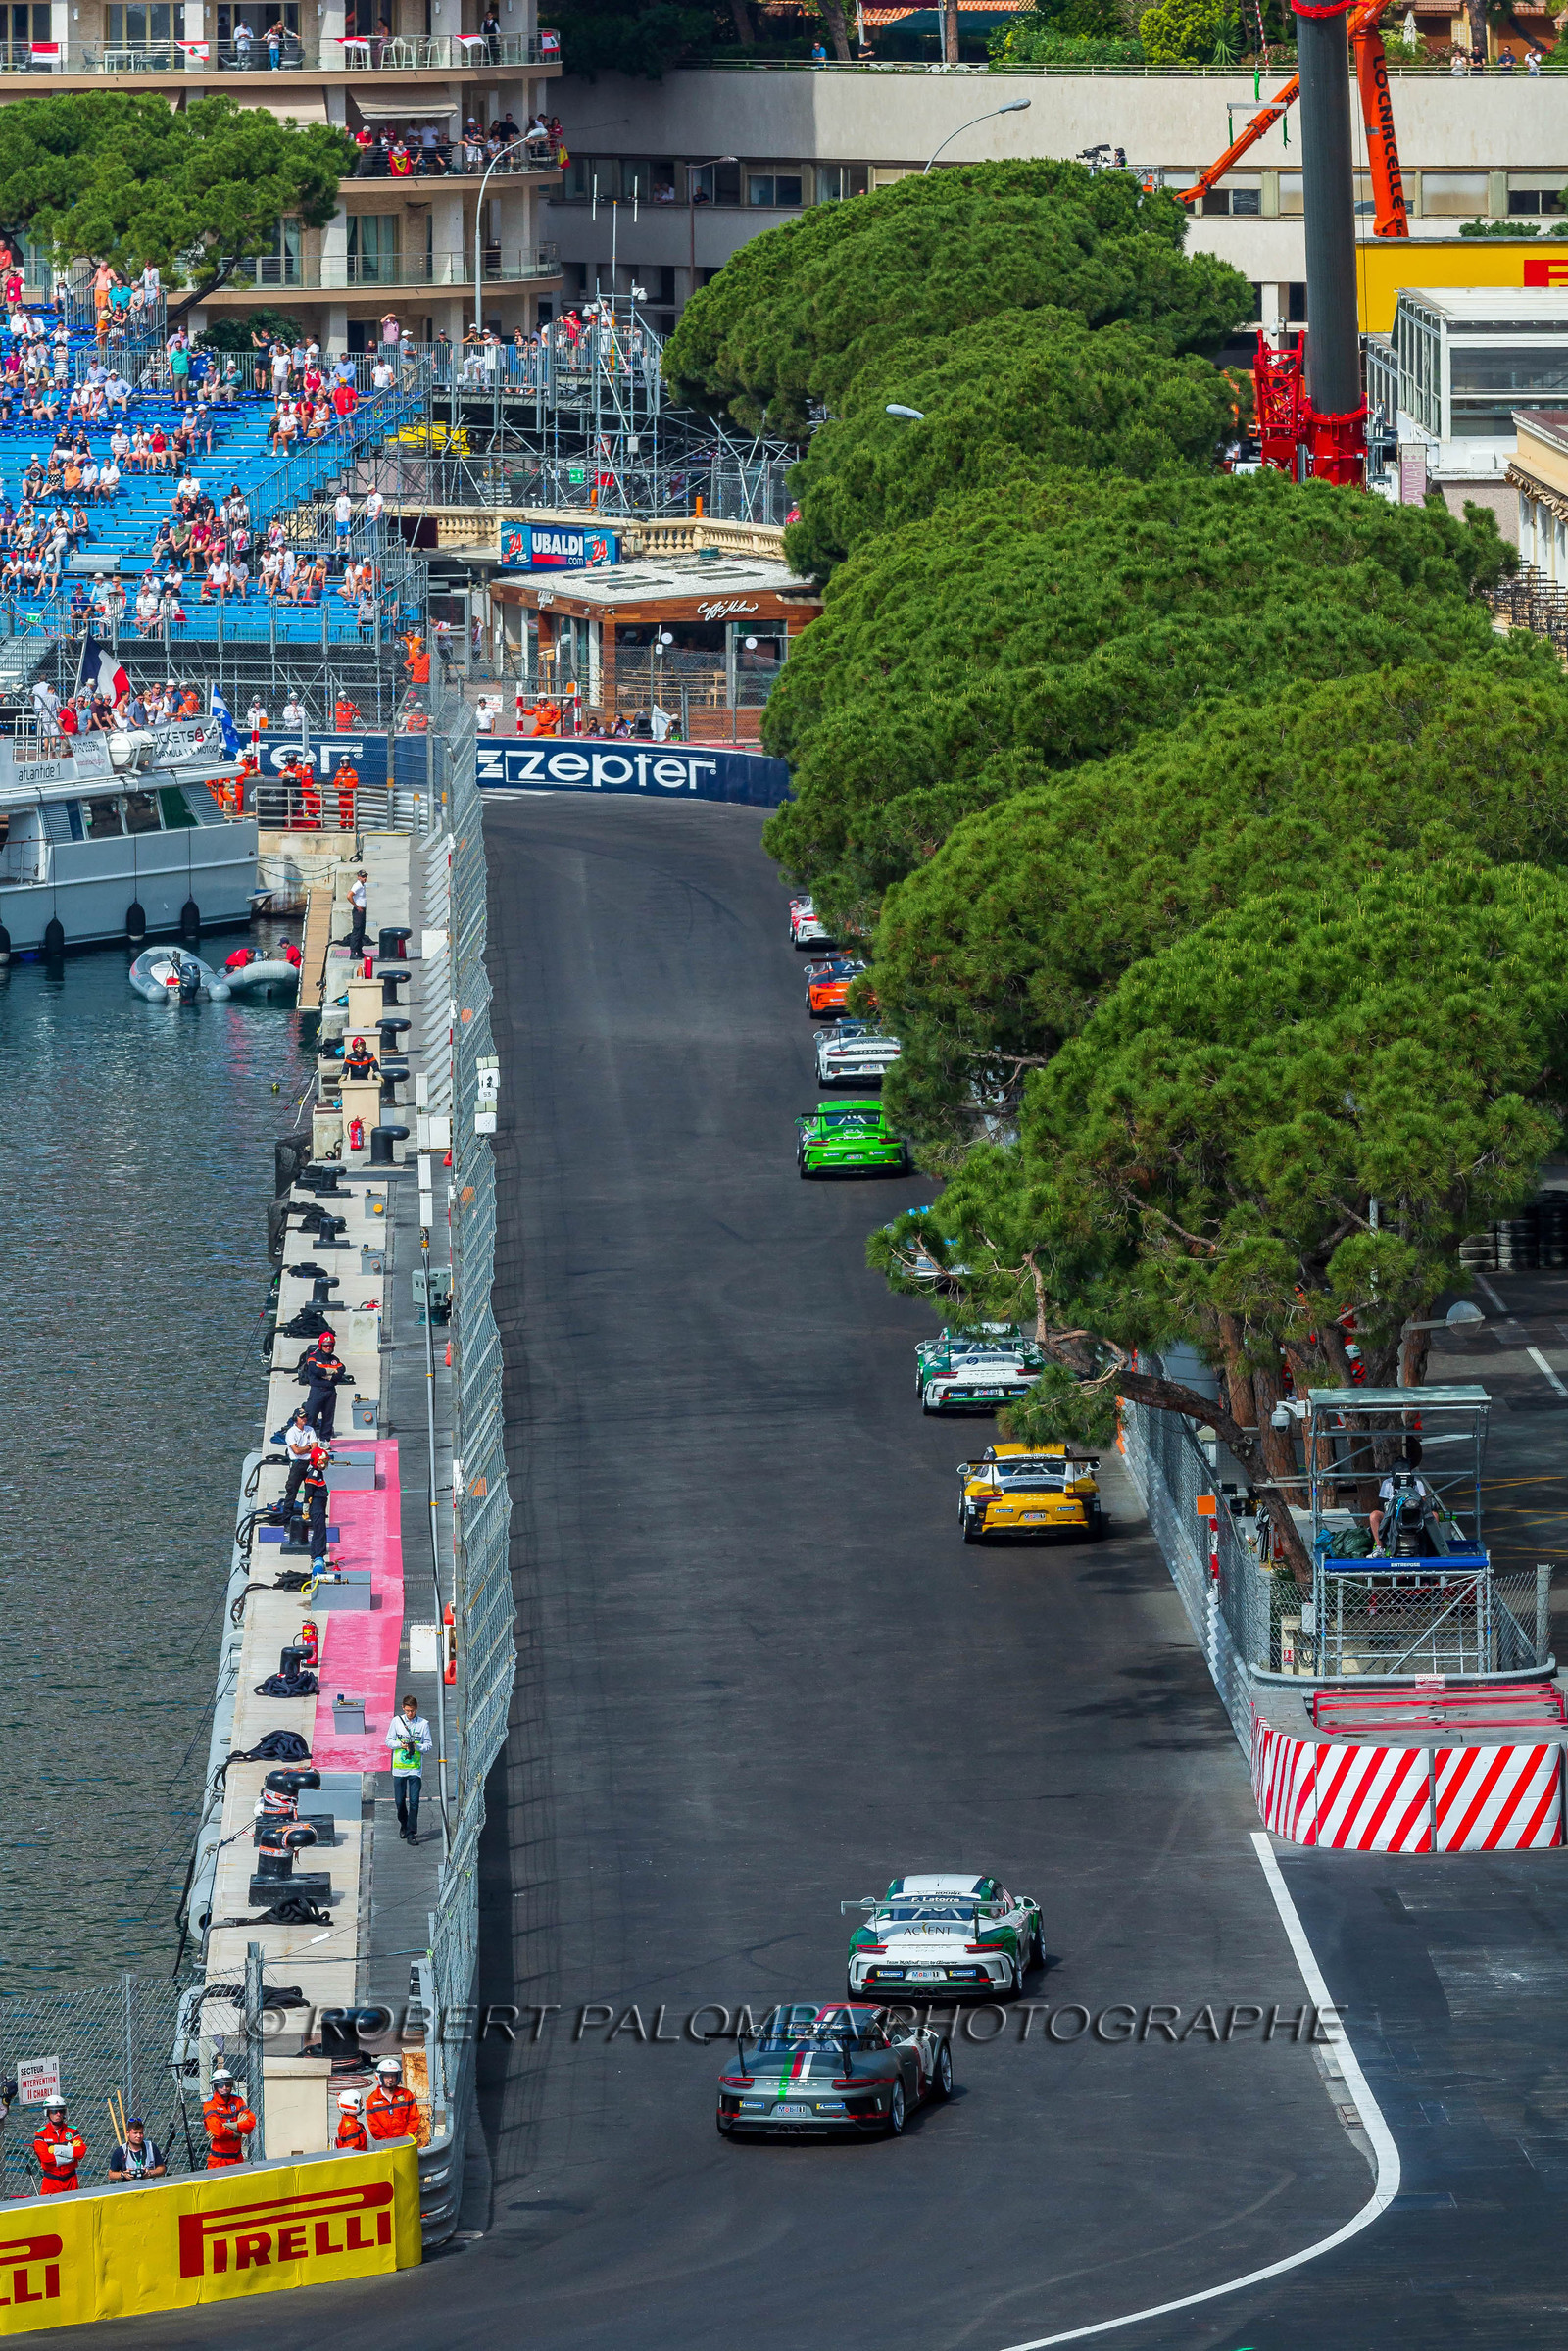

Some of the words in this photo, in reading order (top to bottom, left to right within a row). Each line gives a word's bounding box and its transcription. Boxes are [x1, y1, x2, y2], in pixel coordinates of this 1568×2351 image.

[1373, 55, 1404, 210] LOCNACELLE
[509, 533, 523, 554] 24
[532, 532, 583, 556] UBALDI
[592, 539, 608, 560] 24
[566, 556, 583, 565] .com
[718, 600, 759, 618] Milano
[19, 762, 55, 782] atlantide
[505, 750, 717, 790] zepter
[20, 2065, 44, 2077] SECTEUR
[22, 2076, 56, 2089] INTERVENTION
[33, 2087, 53, 2099] CHARLY
[178, 2181, 394, 2278] PIRELLI
